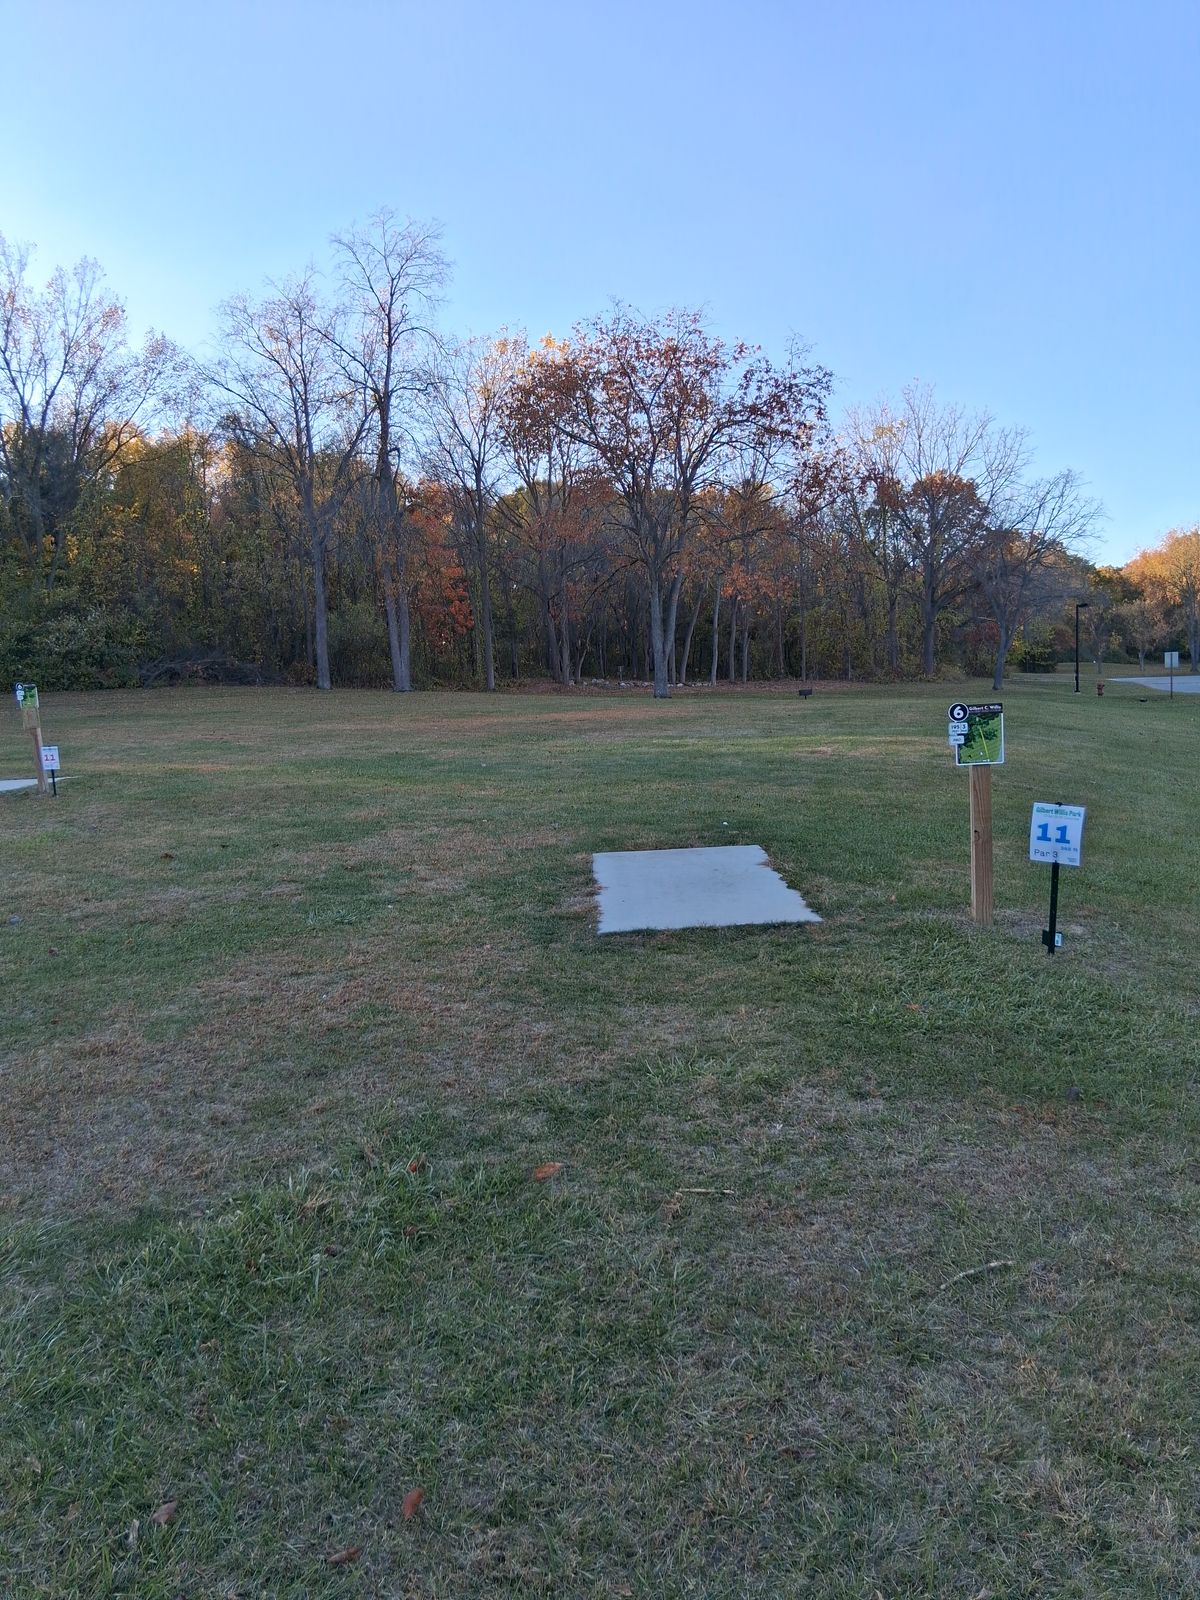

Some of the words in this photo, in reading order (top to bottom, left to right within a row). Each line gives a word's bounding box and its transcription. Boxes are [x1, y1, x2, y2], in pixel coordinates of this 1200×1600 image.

[953, 706, 964, 719] 6
[1036, 822, 1070, 844] 11
[1034, 848, 1050, 857] Par
[1052, 850, 1058, 858] 3
